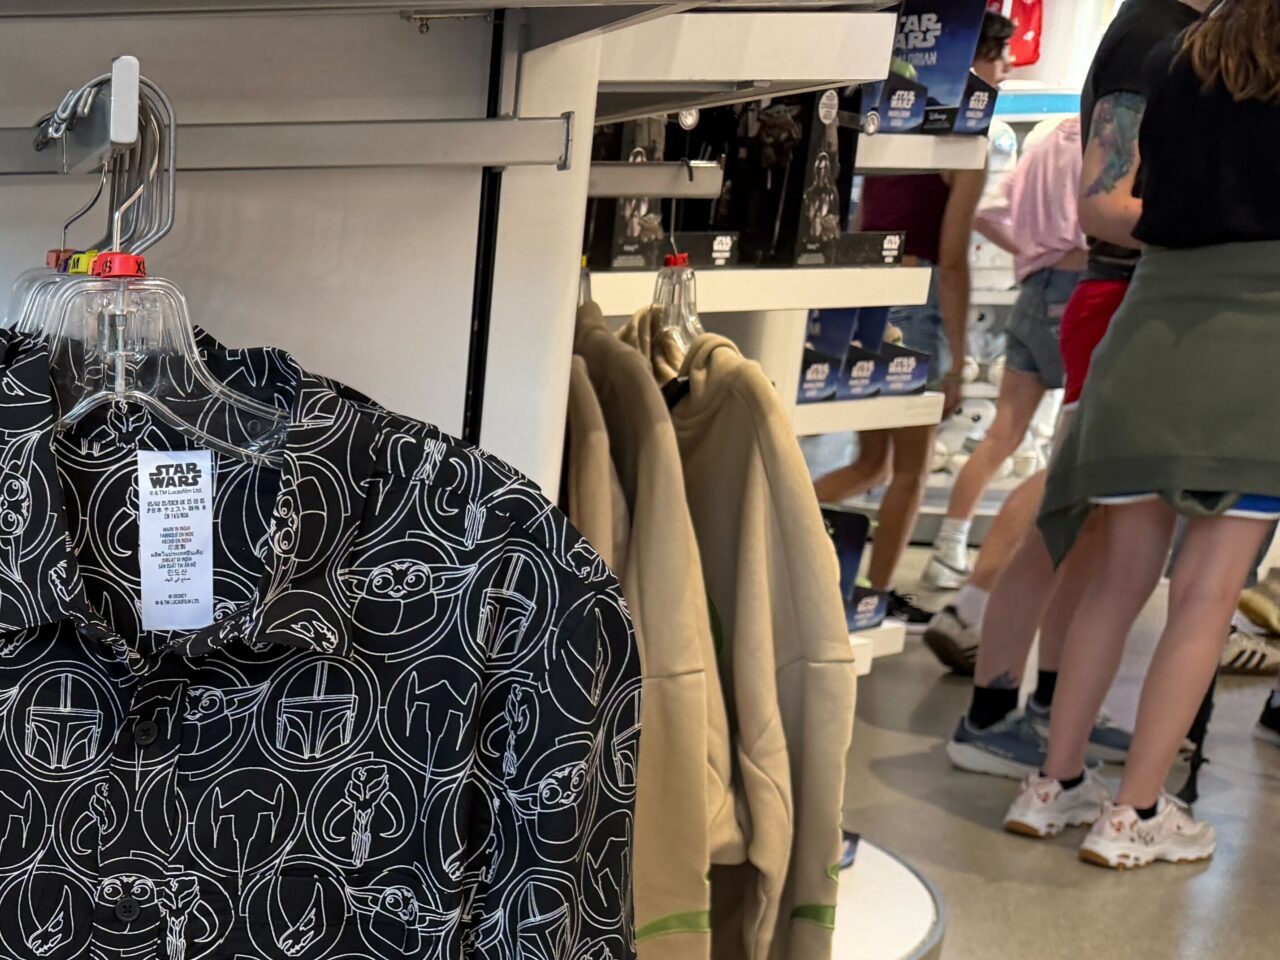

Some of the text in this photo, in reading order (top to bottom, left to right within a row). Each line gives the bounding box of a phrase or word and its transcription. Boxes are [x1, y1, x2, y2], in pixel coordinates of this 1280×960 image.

[895, 30, 942, 49] ARS
[149, 462, 202, 476] STAR
[149, 474, 202, 489] WARS
